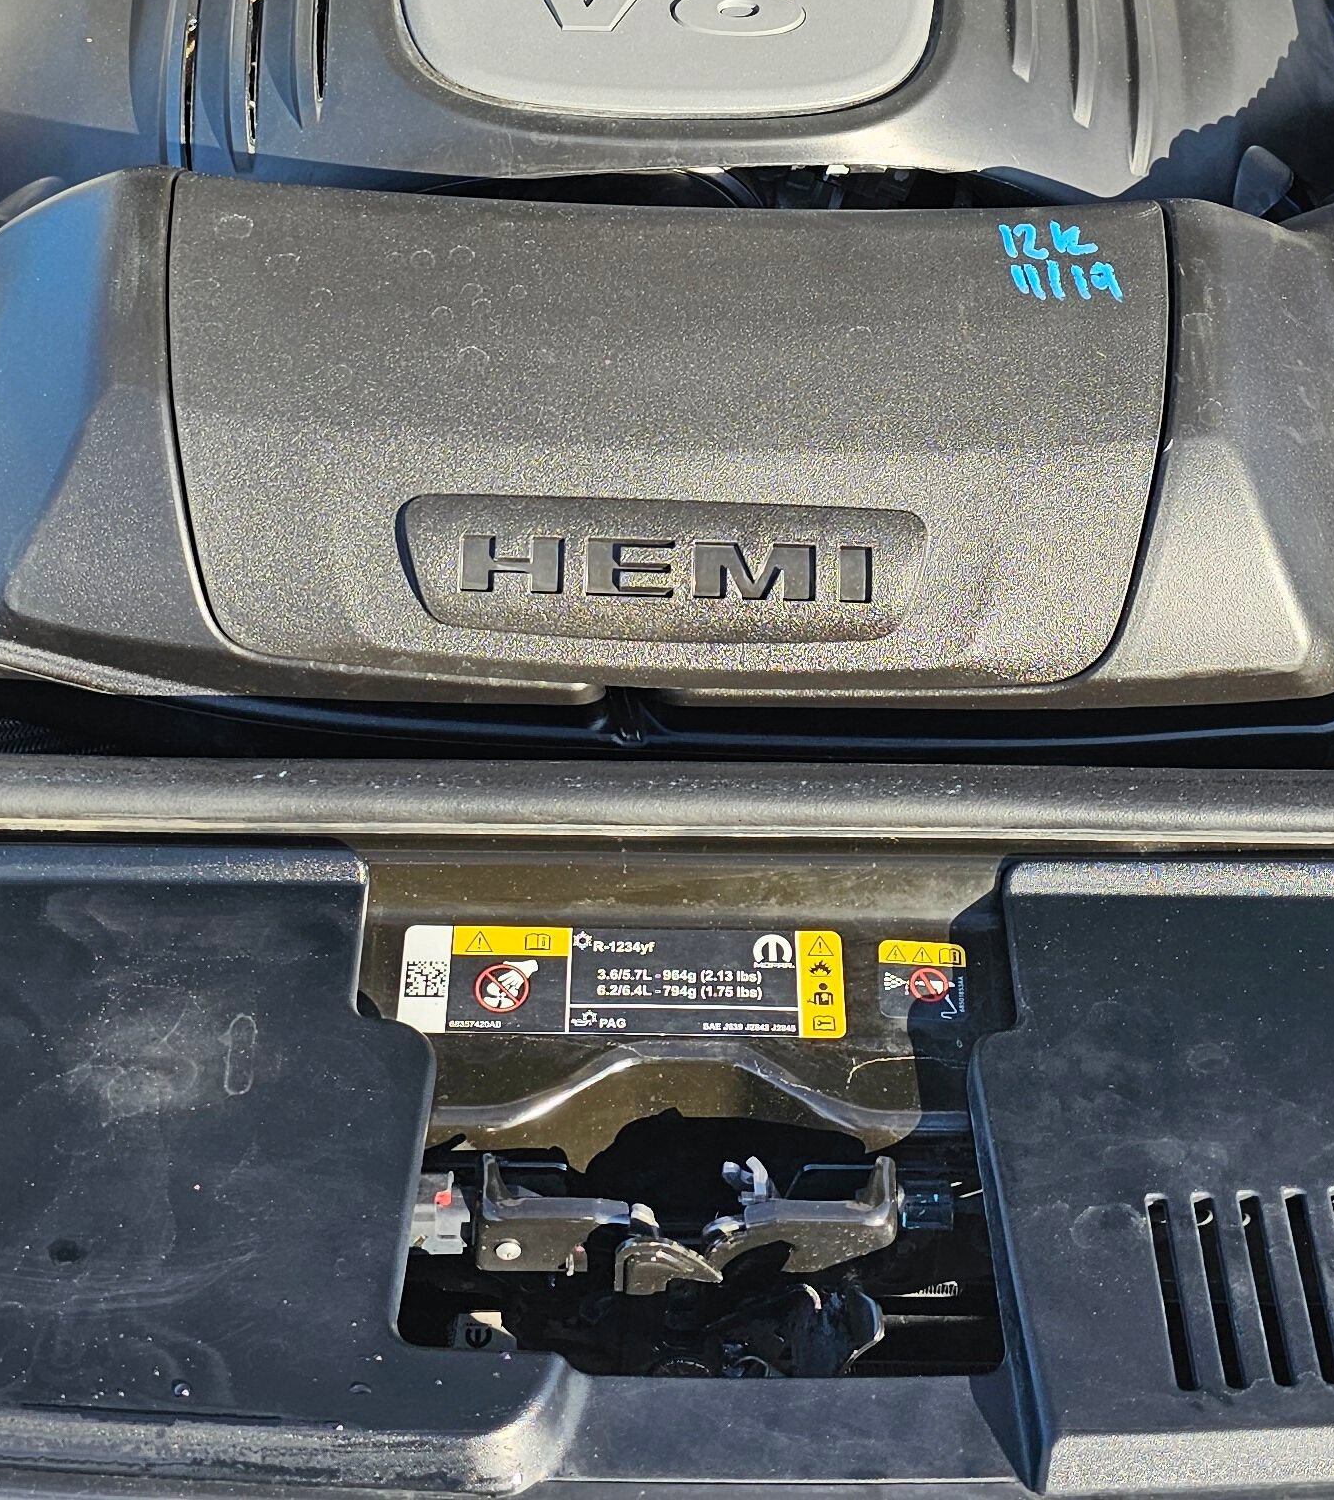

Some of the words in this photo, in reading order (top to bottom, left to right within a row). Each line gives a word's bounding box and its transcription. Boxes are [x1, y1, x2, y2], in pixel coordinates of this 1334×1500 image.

[458, 534, 873, 602] HEMI
[593, 941, 655, 955] R-1234yf
[596, 969, 653, 981] 3.6/5.7L
[700, 969, 734, 984] (2.13
[736, 969, 762, 984] lbs)
[596, 985, 653, 997] 6.2/6.4L
[700, 985, 734, 1000] (1.75
[736, 985, 763, 1000] lbs)
[599, 1017, 627, 1029] PAG
